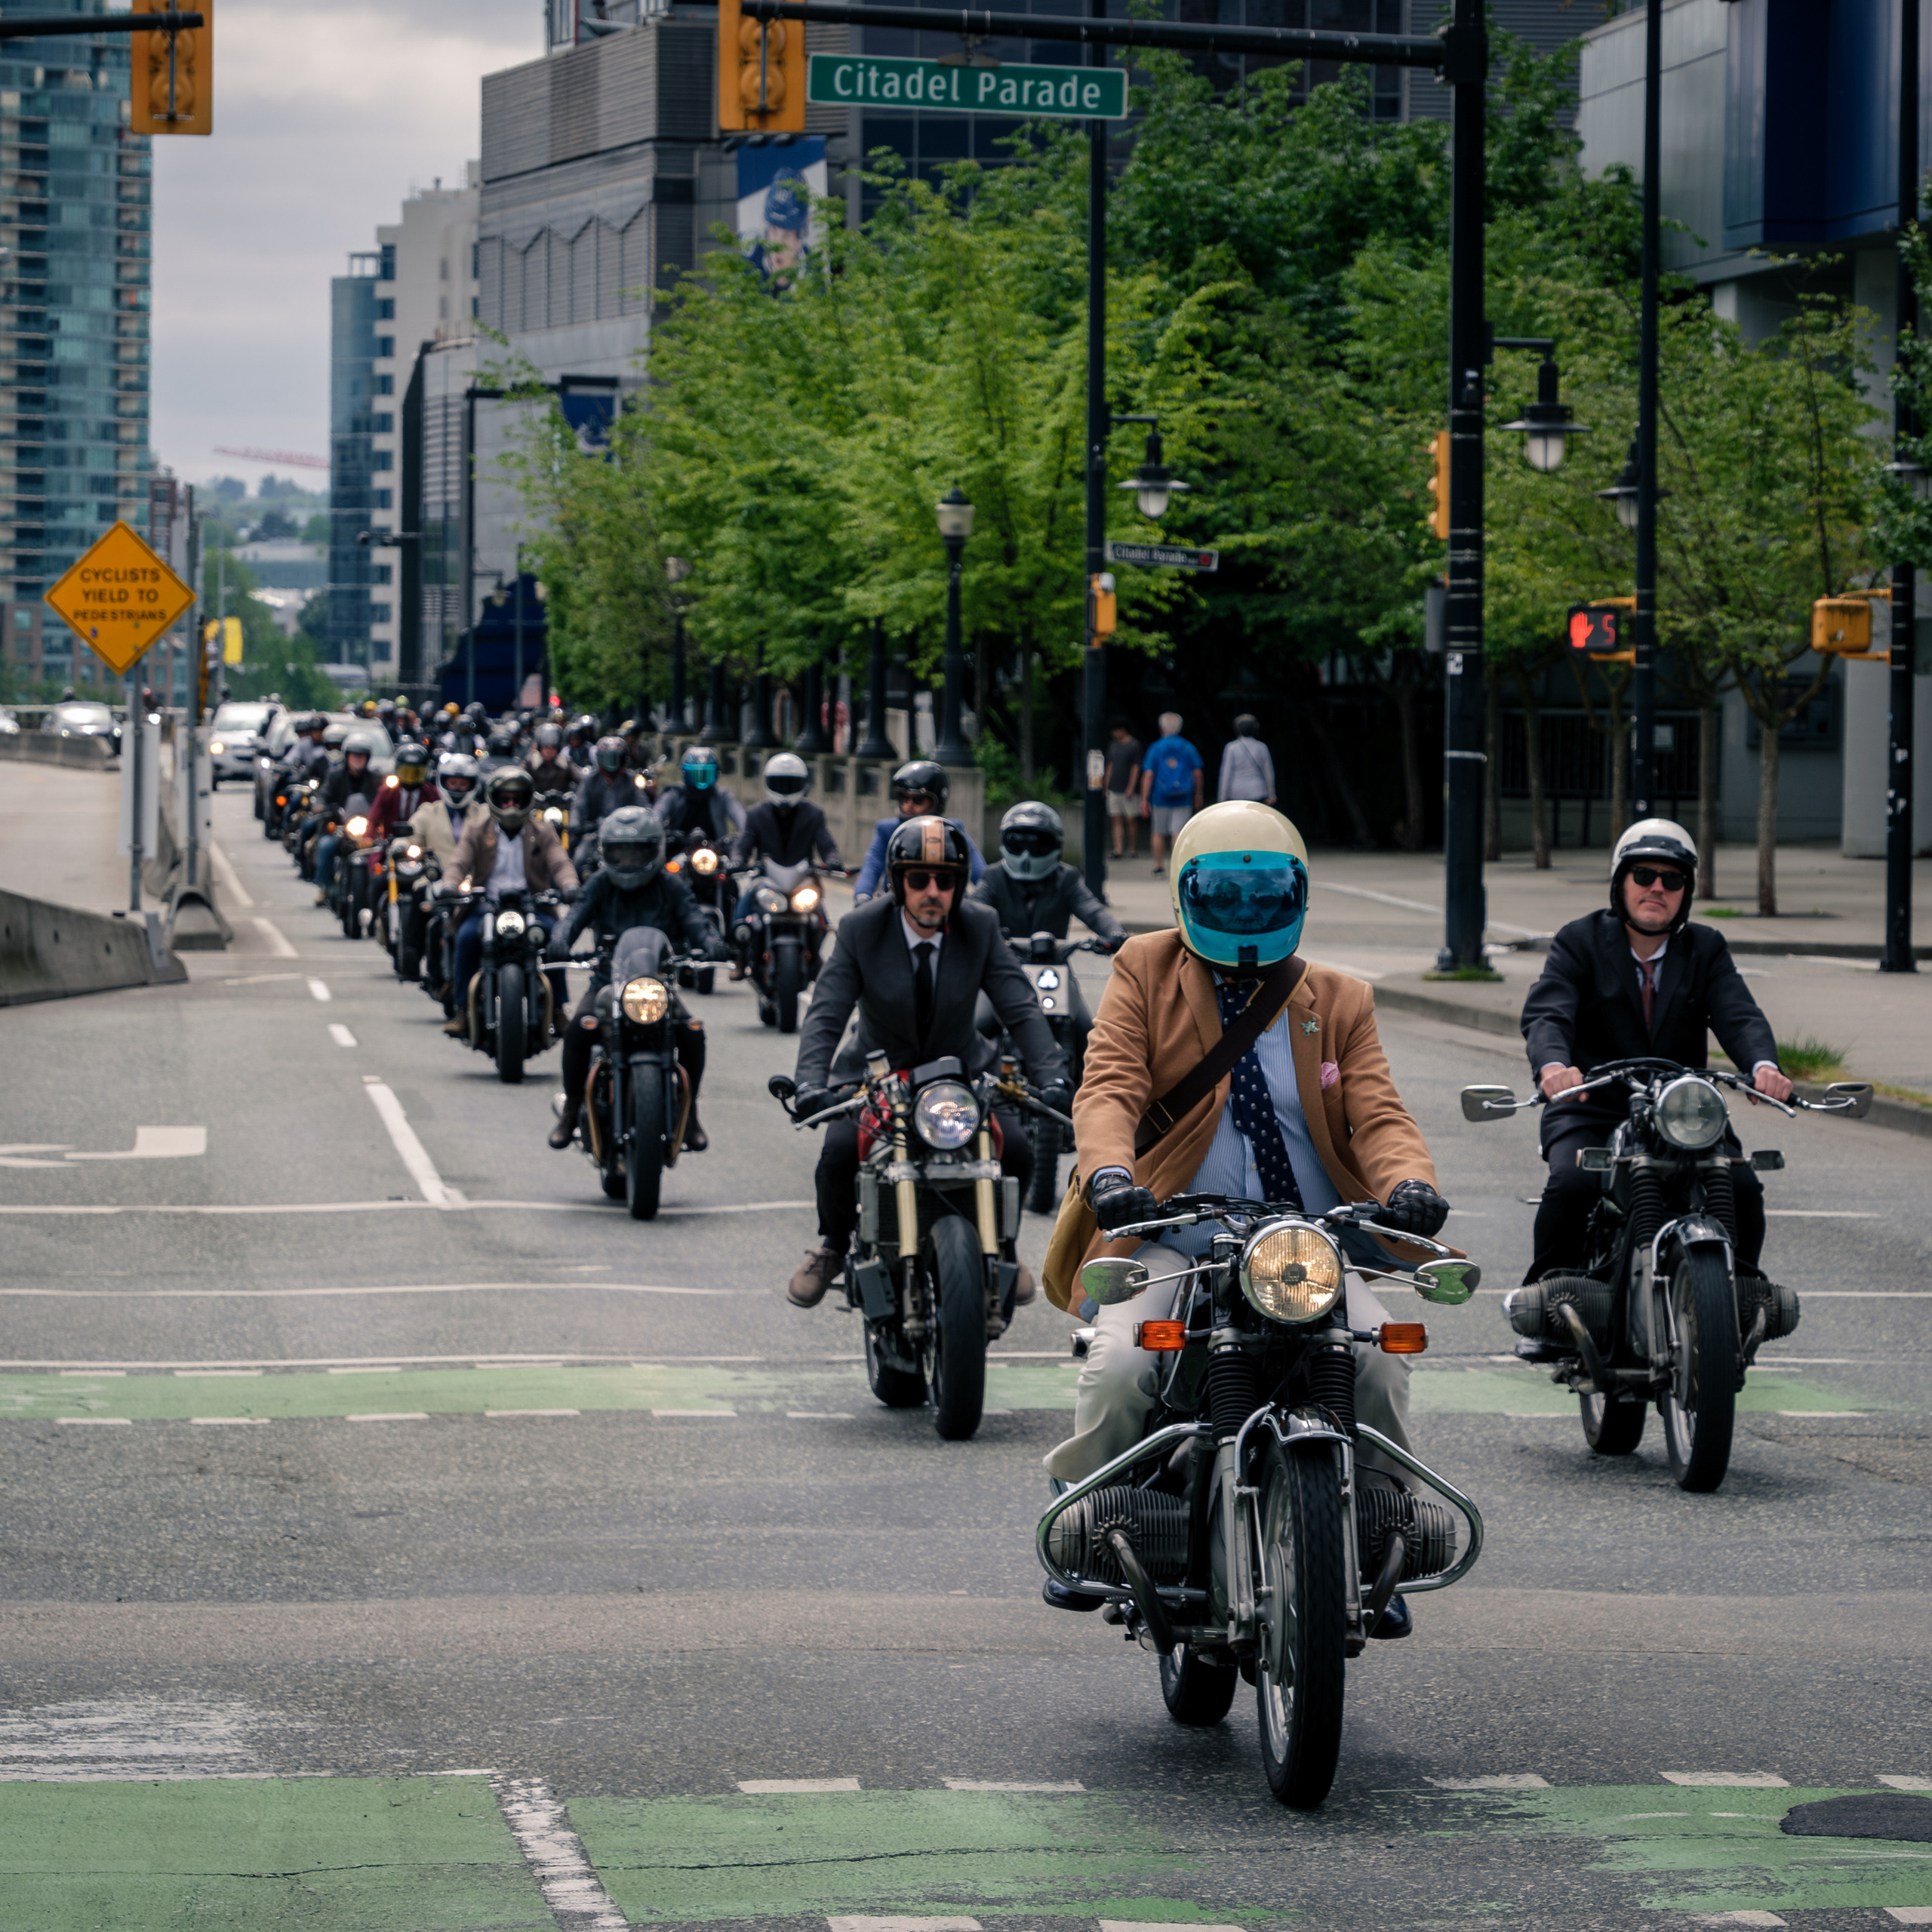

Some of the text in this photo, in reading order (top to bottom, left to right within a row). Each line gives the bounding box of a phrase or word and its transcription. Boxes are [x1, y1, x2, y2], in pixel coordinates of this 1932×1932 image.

[834, 63, 1101, 109] Citadel Parade
[80, 568, 161, 583] CYCLISTS
[82, 588, 159, 603] YIELD TO
[73, 608, 167, 622] PEDESTRIANS
[1601, 614, 1616, 645] 5
